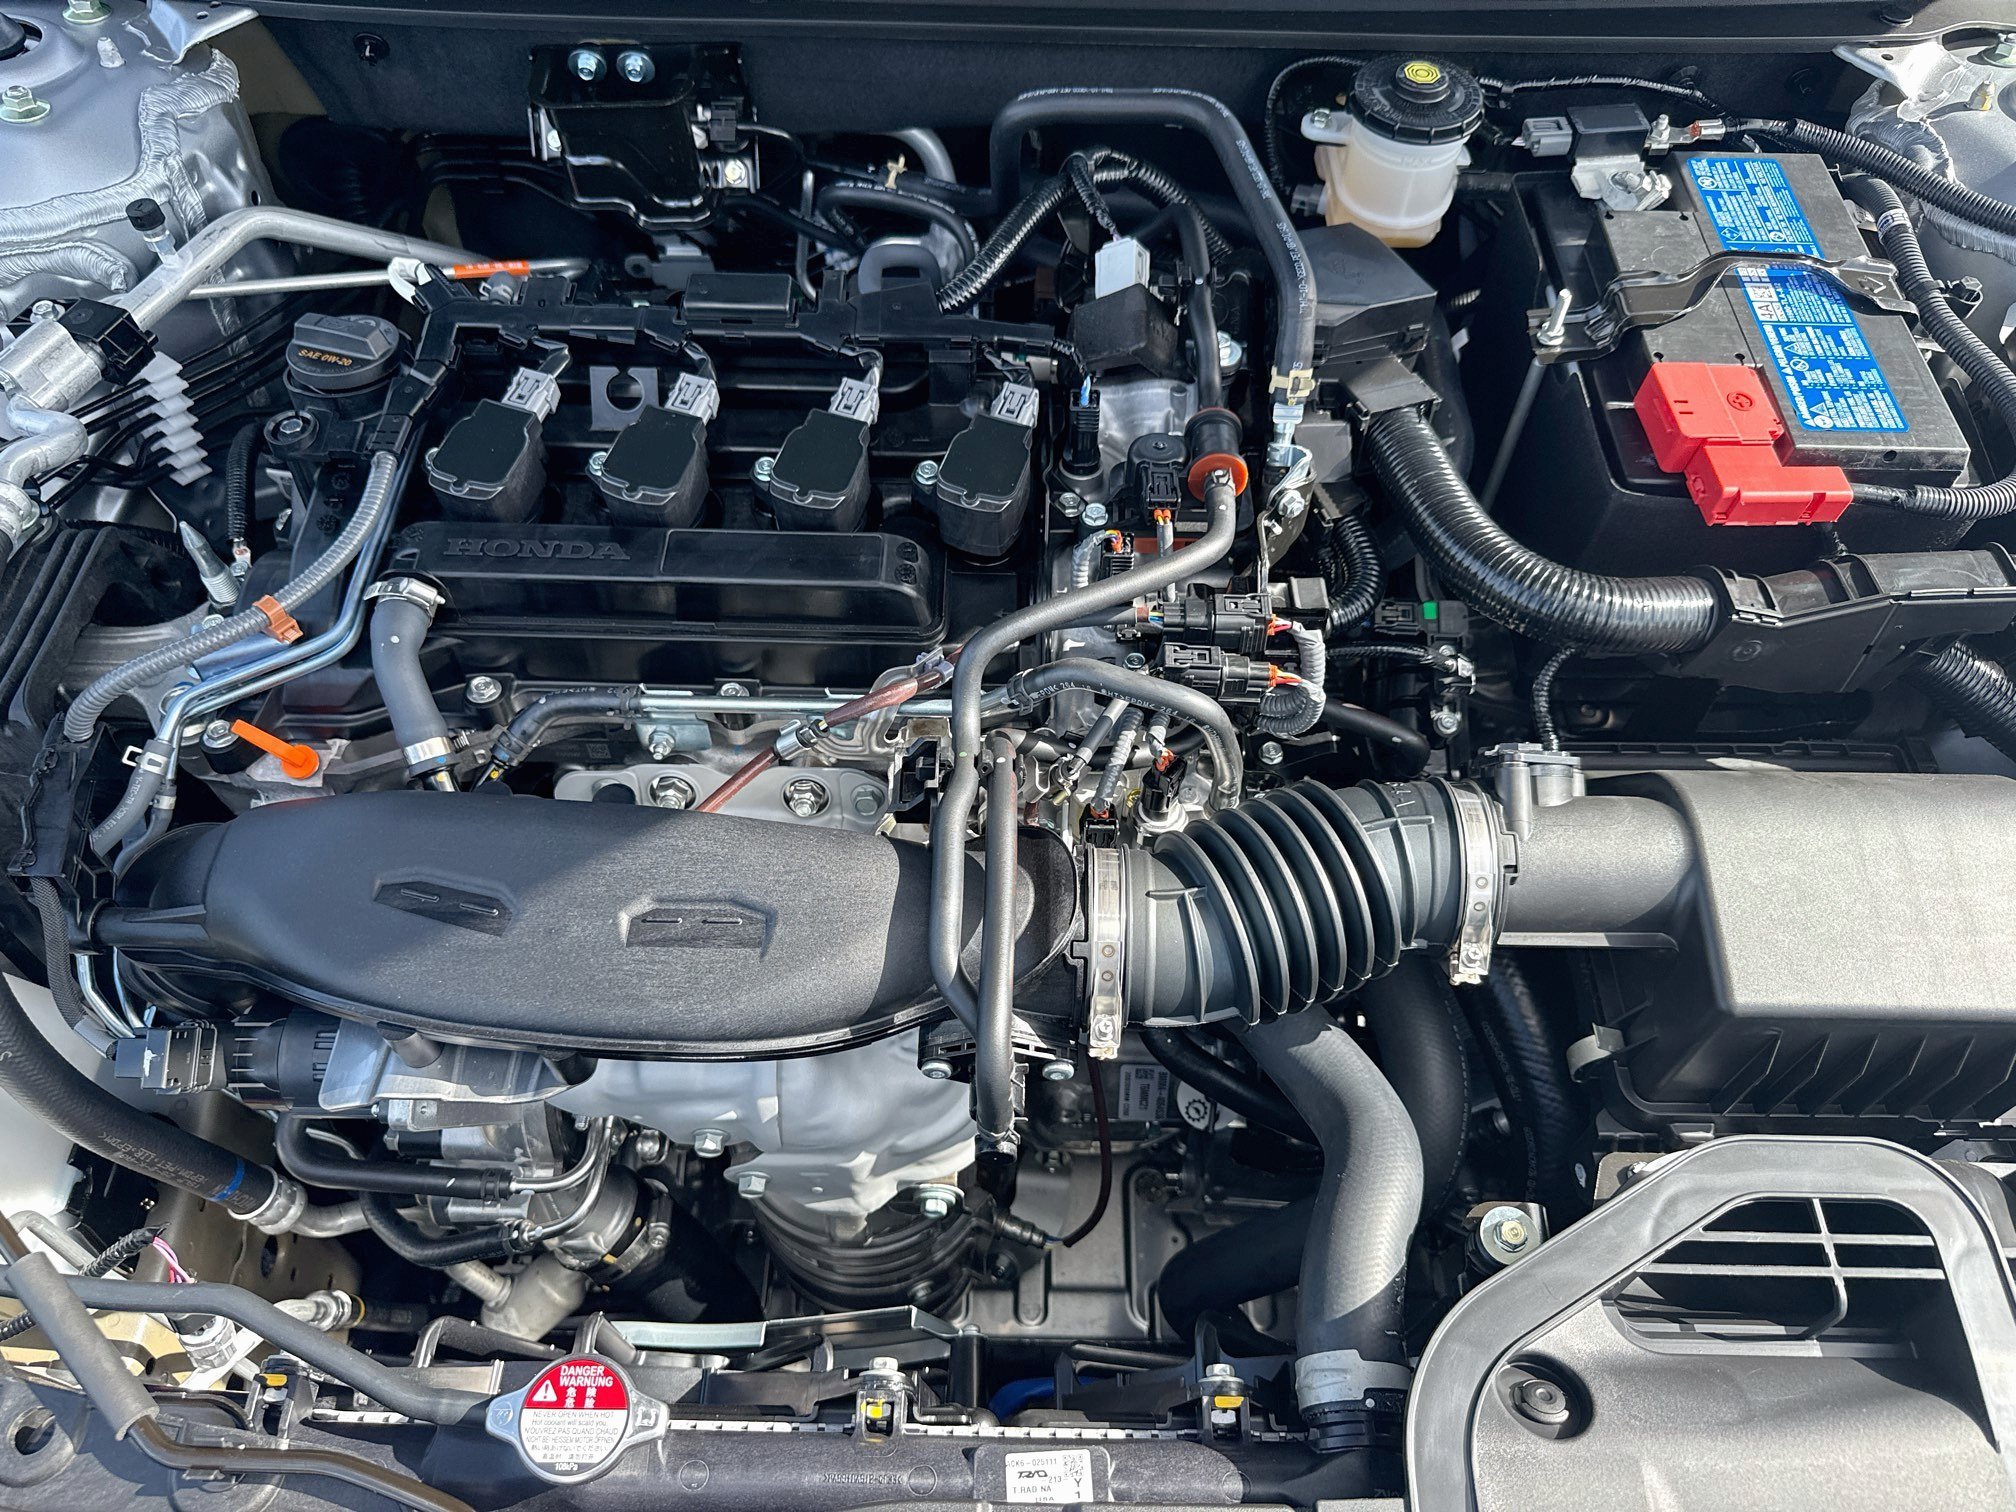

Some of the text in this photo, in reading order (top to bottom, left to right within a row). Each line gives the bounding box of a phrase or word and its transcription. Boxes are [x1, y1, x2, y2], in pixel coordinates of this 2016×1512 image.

[1757, 303, 1774, 320] 4A
[298, 349, 353, 367] SAE 0W-20
[443, 538, 631, 560] HONDA
[561, 1365, 604, 1376] DANGER
[559, 1376, 614, 1387] WARNUNG
[600, 1411, 615, 1419] HOT
[557, 1427, 571, 1435] PAS
[1073, 1478, 1083, 1488] Y
[1074, 1490, 1081, 1499] 1
